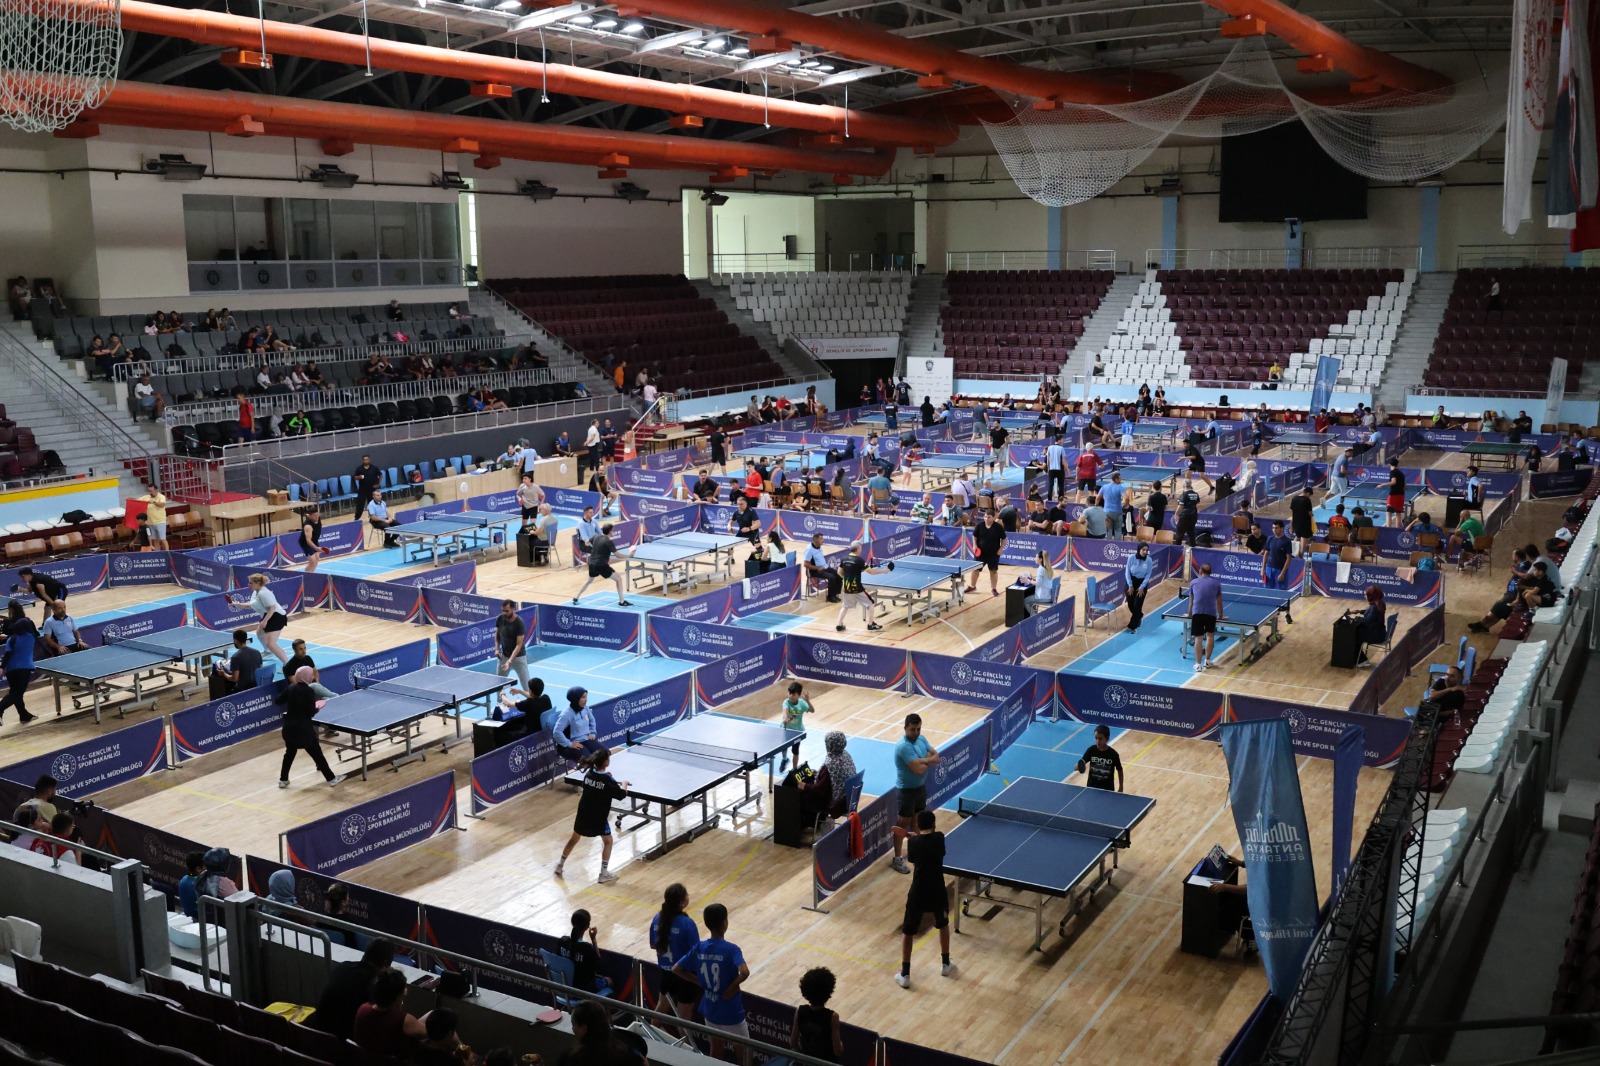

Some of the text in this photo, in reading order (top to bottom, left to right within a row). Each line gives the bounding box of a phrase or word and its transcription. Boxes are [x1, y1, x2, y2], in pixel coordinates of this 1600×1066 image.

[1140, 694, 1165, 703] GENÇLİK
[1144, 701, 1173, 709] BAKANLIĞI
[237, 708, 249, 717] SPOR
[1100, 712, 1124, 720] GENÇLİK
[1156, 719, 1195, 729] MÜDÜRLÜĞÜ
[198, 736, 214, 747] HATAY
[242, 722, 255, 731] SPOR
[261, 711, 283, 725] MÜDÜRLÜ
[1320, 719, 1347, 729] GENÇLİK
[1323, 727, 1342, 735] BAKAN
[77, 754, 87, 762] T.C.
[88, 745, 112, 759] GENÇLİK
[1312, 742, 1328, 750] SPOR
[78, 749, 121, 770] SPOR BAKANLIĞI
[56, 783, 76, 796] ENÇLİK
[85, 775, 100, 786] SPOR
[107, 759, 143, 778] MÜDÜRLÜĞÜ
[805, 768, 813, 777] 3
[366, 802, 410, 823] T.C. GENÇLİK VE
[367, 809, 411, 831] SPOR BAKANLIĞI
[318, 819, 432, 871] HATAY GENÇLİK VE SPOR İL MÜDÜRLÜĞÜ
[700, 962, 720, 992] 18
[756, 1014, 791, 1032] GENÇLİK
[746, 1022, 791, 1042] POR BAKAN
